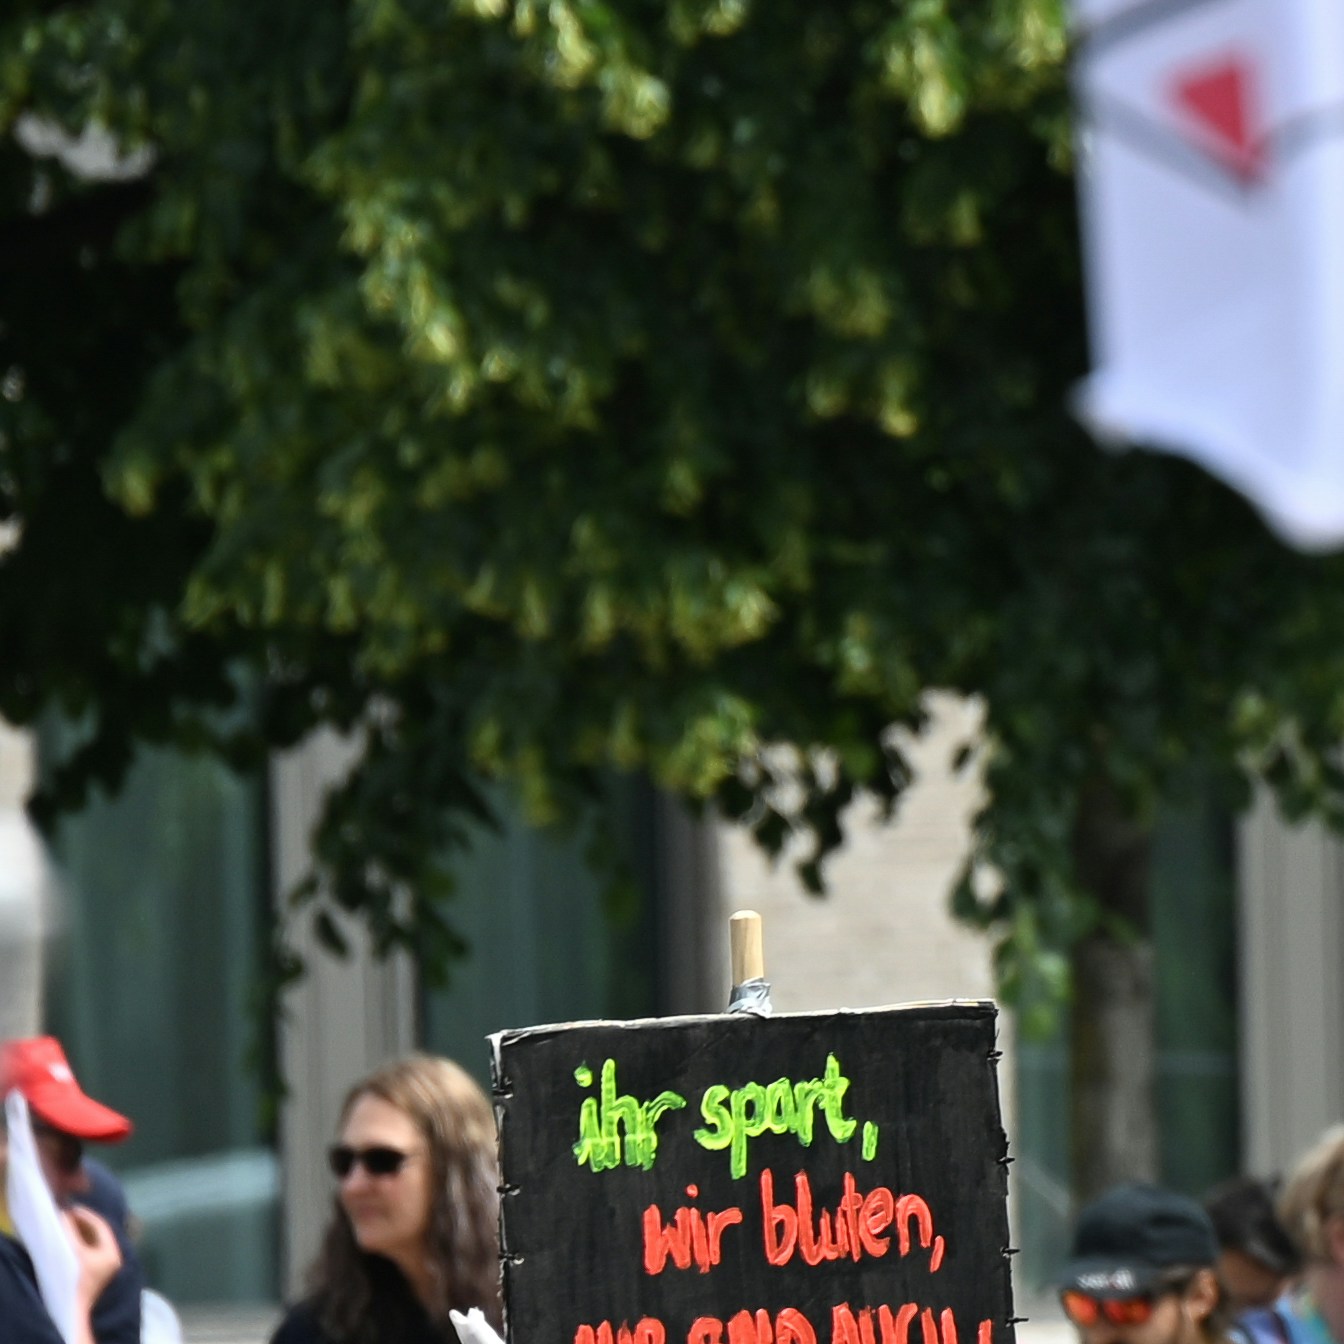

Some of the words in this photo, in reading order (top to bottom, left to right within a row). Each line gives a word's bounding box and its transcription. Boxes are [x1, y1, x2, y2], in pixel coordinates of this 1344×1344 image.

[571, 1058, 686, 1172] ihr
[693, 1052, 879, 1179] spart,
[643, 1184, 743, 1275] wir
[761, 1167, 945, 1272] bluten,
